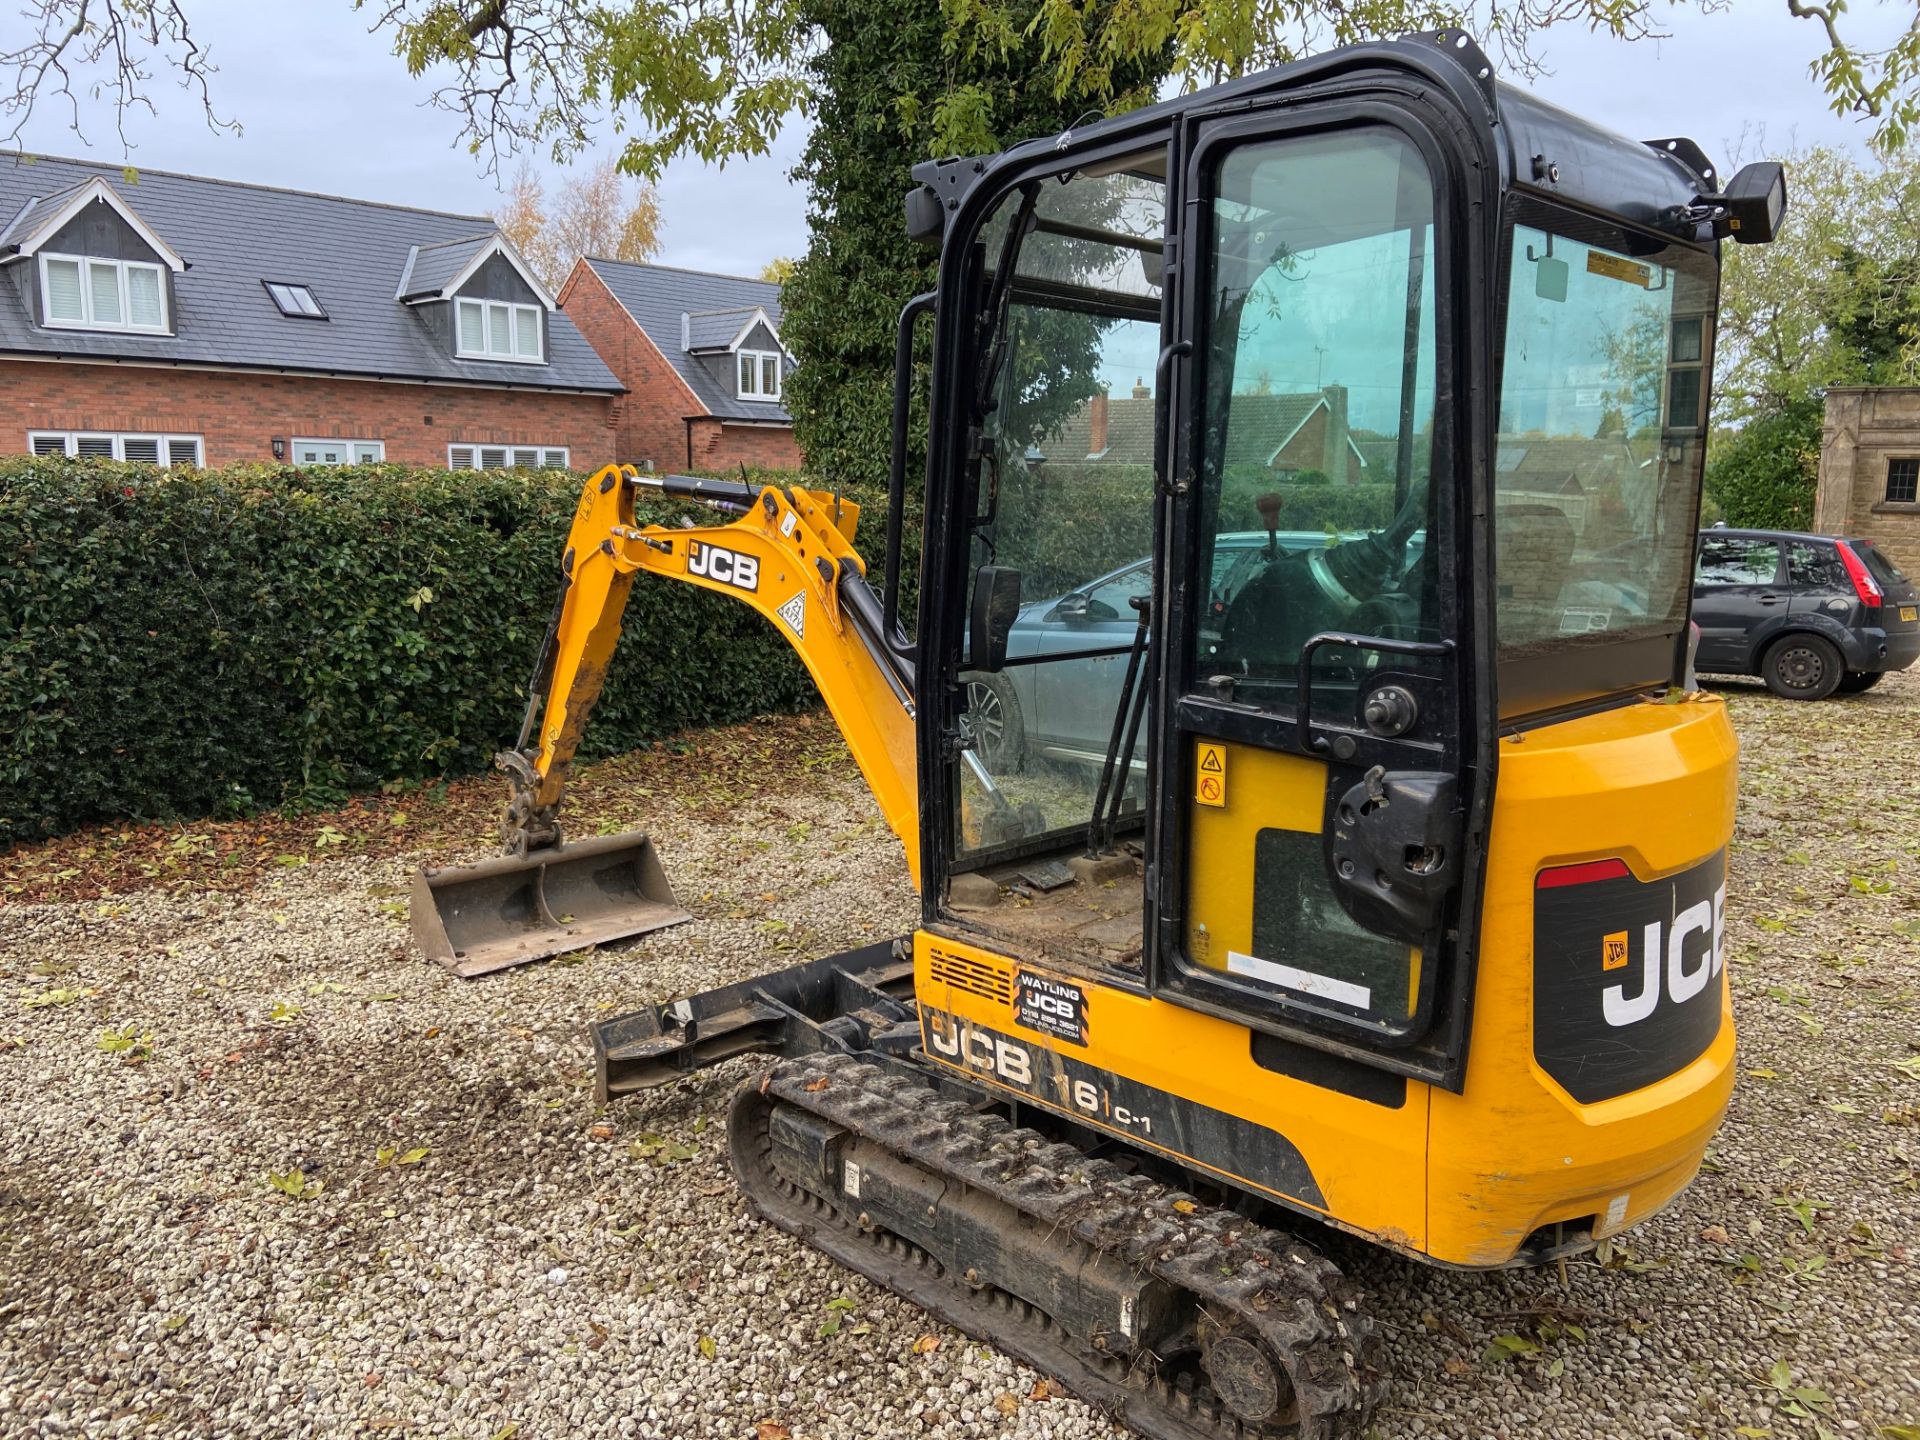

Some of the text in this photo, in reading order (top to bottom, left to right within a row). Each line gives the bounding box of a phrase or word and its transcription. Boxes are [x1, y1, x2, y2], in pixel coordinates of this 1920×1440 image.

[689, 545, 759, 590] JCB
[1608, 943, 1625, 962] JCB
[1021, 974, 1080, 1001] WATLING
[1026, 992, 1075, 1019] JCB
[932, 1023, 1152, 1133] JCB 16 C-1
